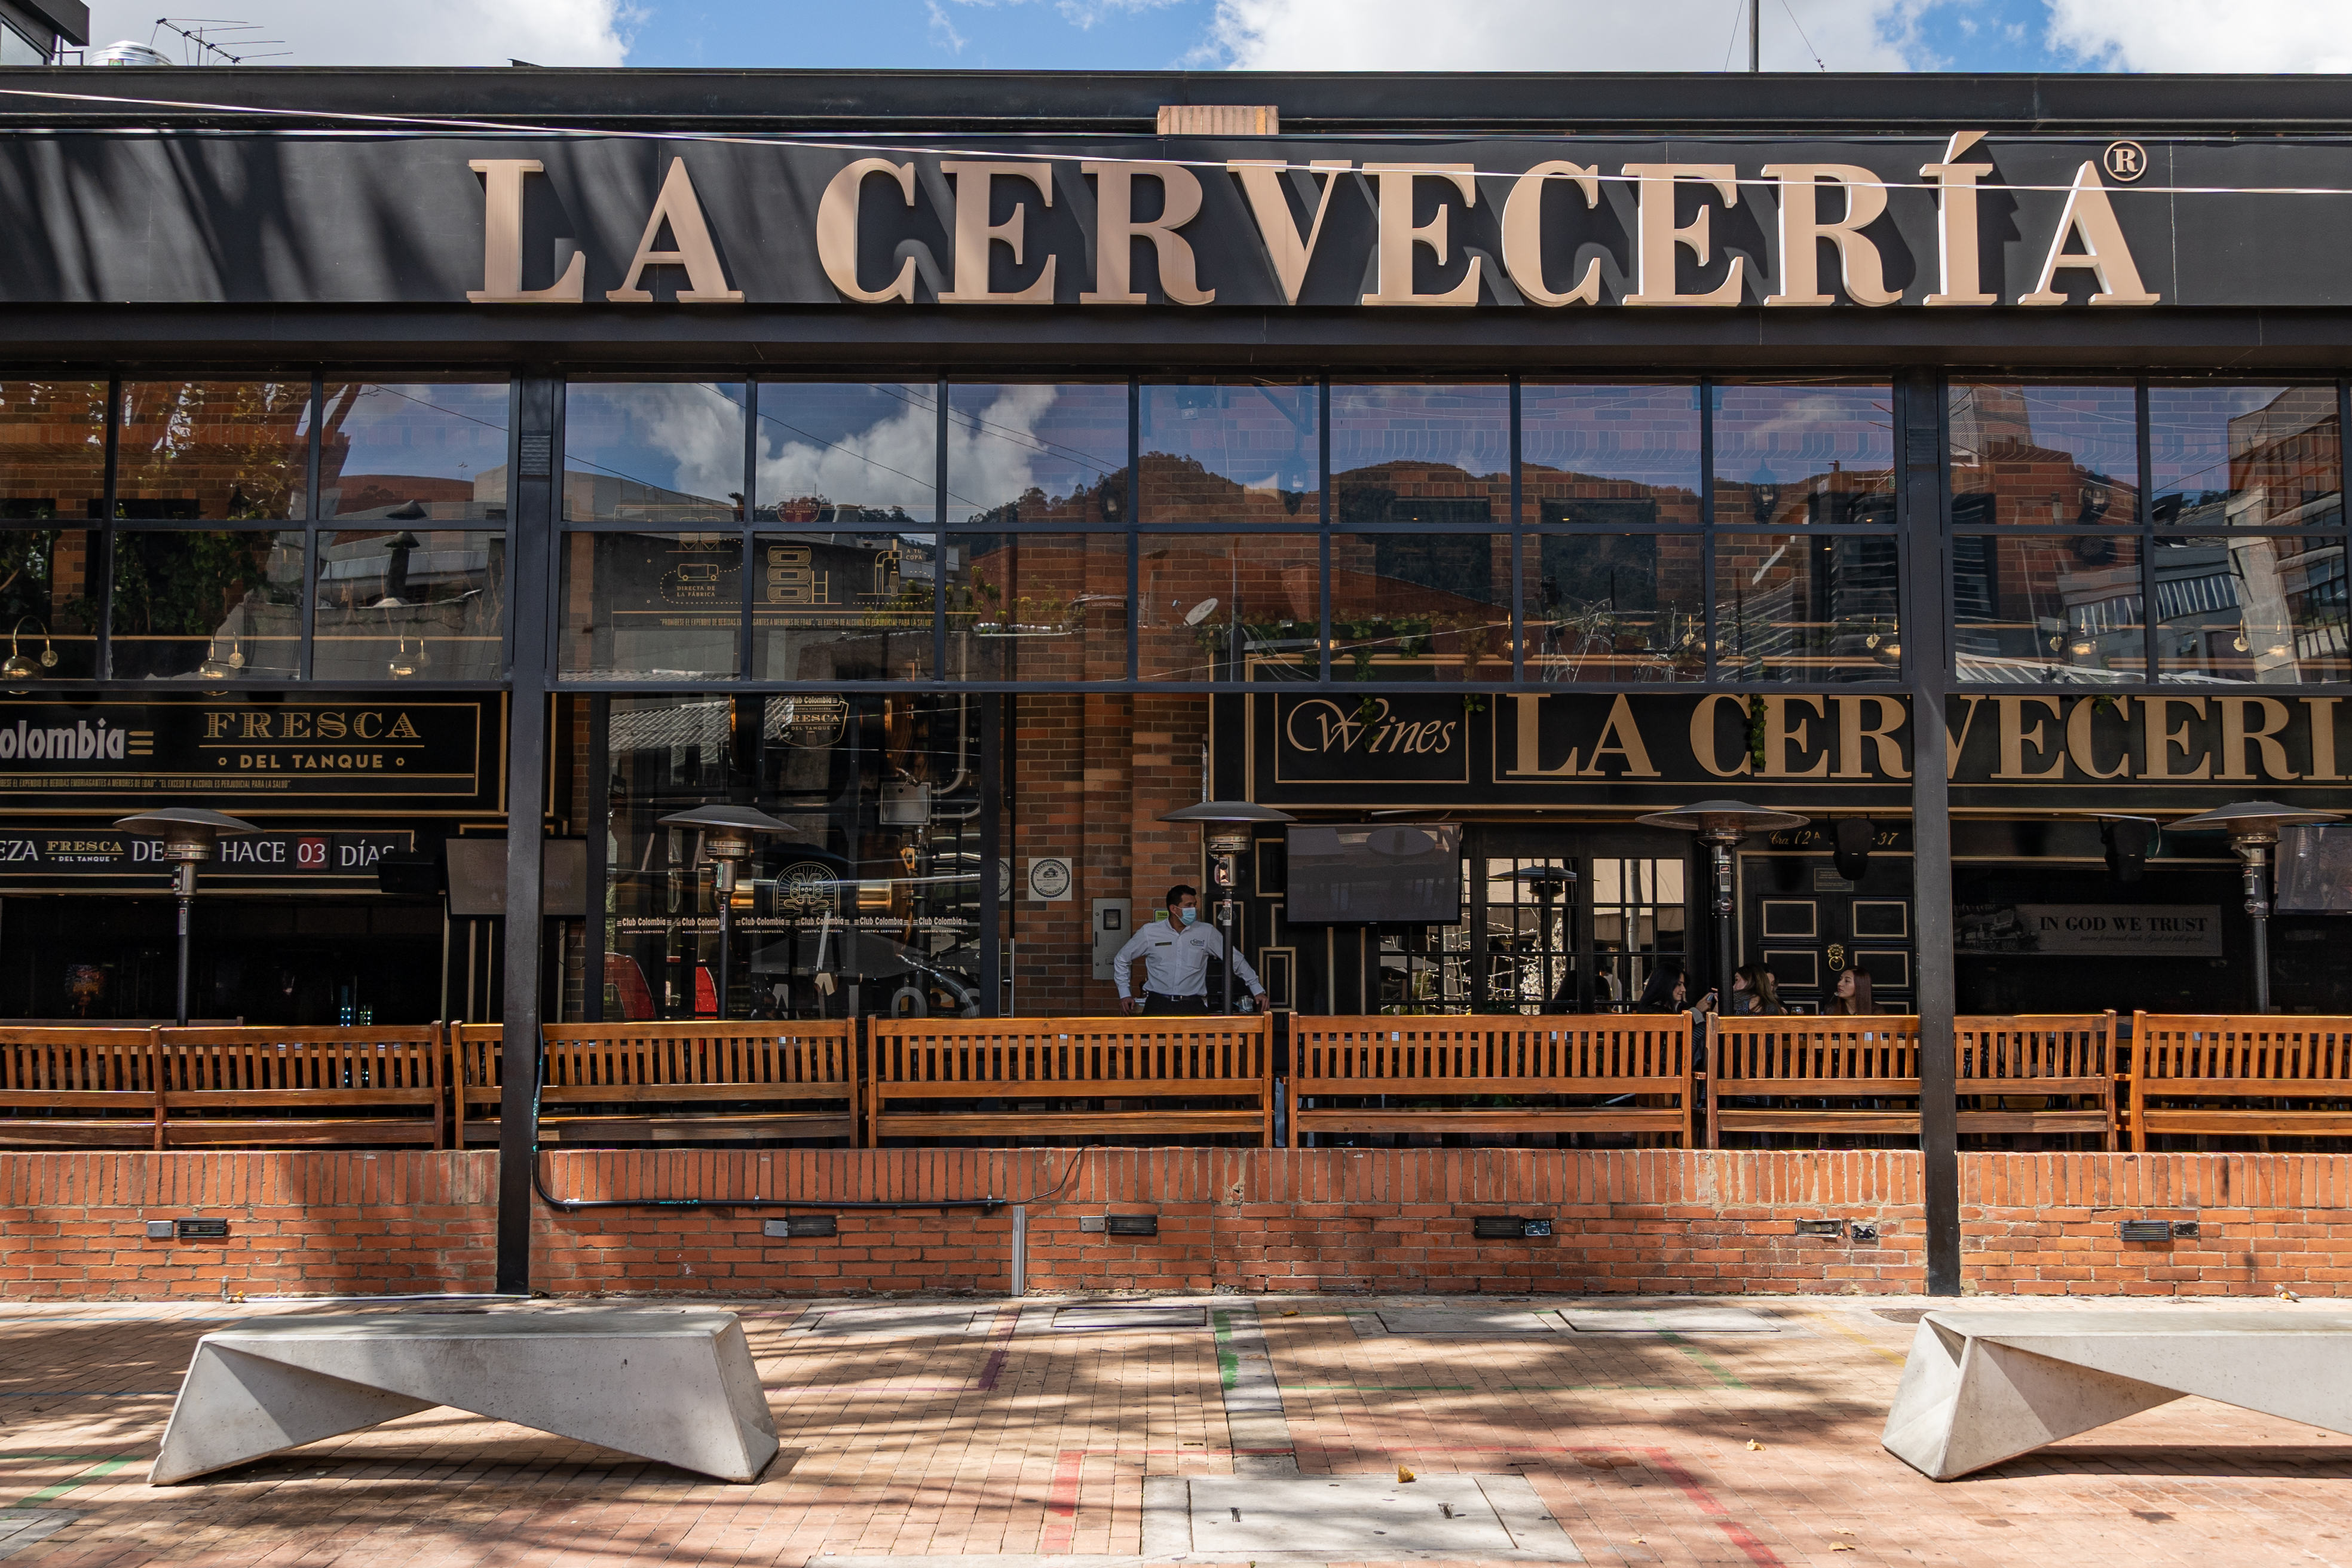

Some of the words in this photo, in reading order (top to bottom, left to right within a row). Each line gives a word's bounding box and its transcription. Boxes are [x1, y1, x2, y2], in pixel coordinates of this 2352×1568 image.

[466, 157, 745, 302] LA
[817, 130, 2160, 308] CERVECERÍA
[685, 618, 690, 626] EL
[804, 696, 832, 704] Colombia
[203, 712, 421, 739] FRESCA
[1287, 698, 1456, 754] Wines
[0, 717, 125, 759] olombia
[1506, 694, 1661, 777] LA
[240, 755, 280, 768] DEL
[292, 755, 383, 769] TANQUE
[1769, 831, 1788, 844] Cra
[47, 841, 123, 852] FRESCA
[220, 841, 286, 862] HACE
[298, 843, 326, 863] 03
[1035, 862, 1065, 875] ESTABLECIMIENTO
[1039, 886, 1062, 895] AUTORIZADO
[623, 917, 636, 926] Club
[638, 917, 666, 926] Colombia
[682, 917, 695, 926] Club
[697, 917, 720, 926] Colomb
[742, 917, 755, 926] Club
[757, 917, 785, 926] Colombia
[801, 917, 814, 925] Club
[816, 917, 844, 925] Colombia
[859, 917, 873, 925] Club
[875, 917, 903, 926] Colombia
[918, 917, 932, 925] Club
[933, 917, 962, 925] Colombia
[2039, 917, 2059, 930] IN
[2065, 916, 2106, 931] GOD
[2112, 917, 2140, 932] WE
[2146, 917, 2207, 932] TRUST
